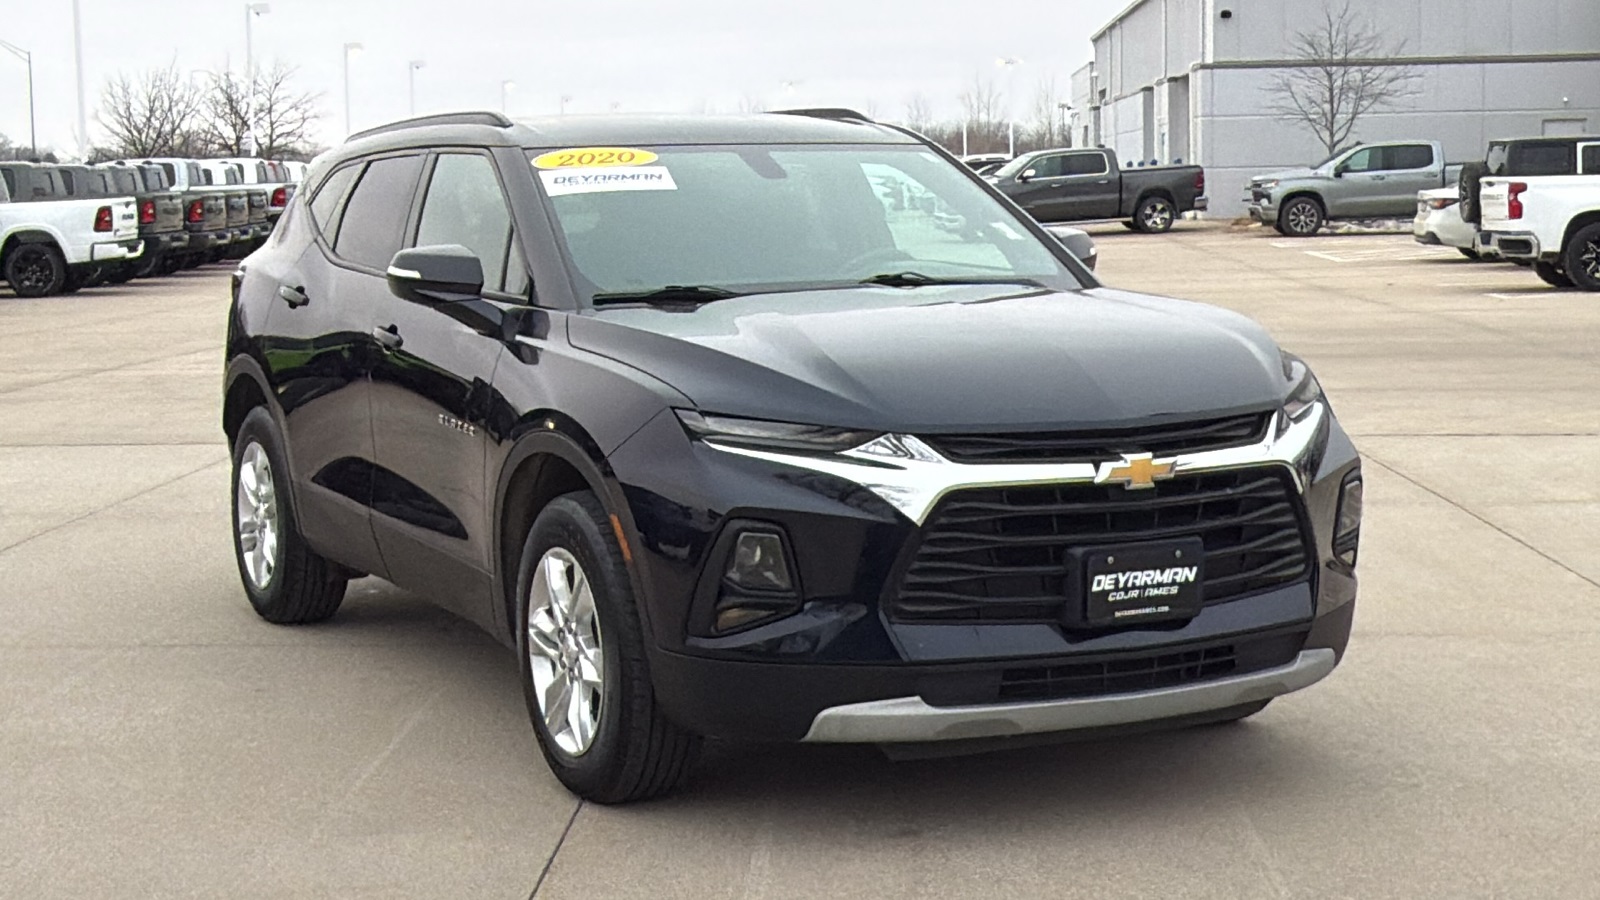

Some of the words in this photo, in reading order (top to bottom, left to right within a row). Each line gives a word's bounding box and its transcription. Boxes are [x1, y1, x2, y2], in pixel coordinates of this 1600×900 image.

[557, 151, 635, 167] 2020
[553, 173, 663, 185] DEYARMAN
[1091, 566, 1198, 592] DEYARMAN
[1144, 585, 1179, 598] AMES
